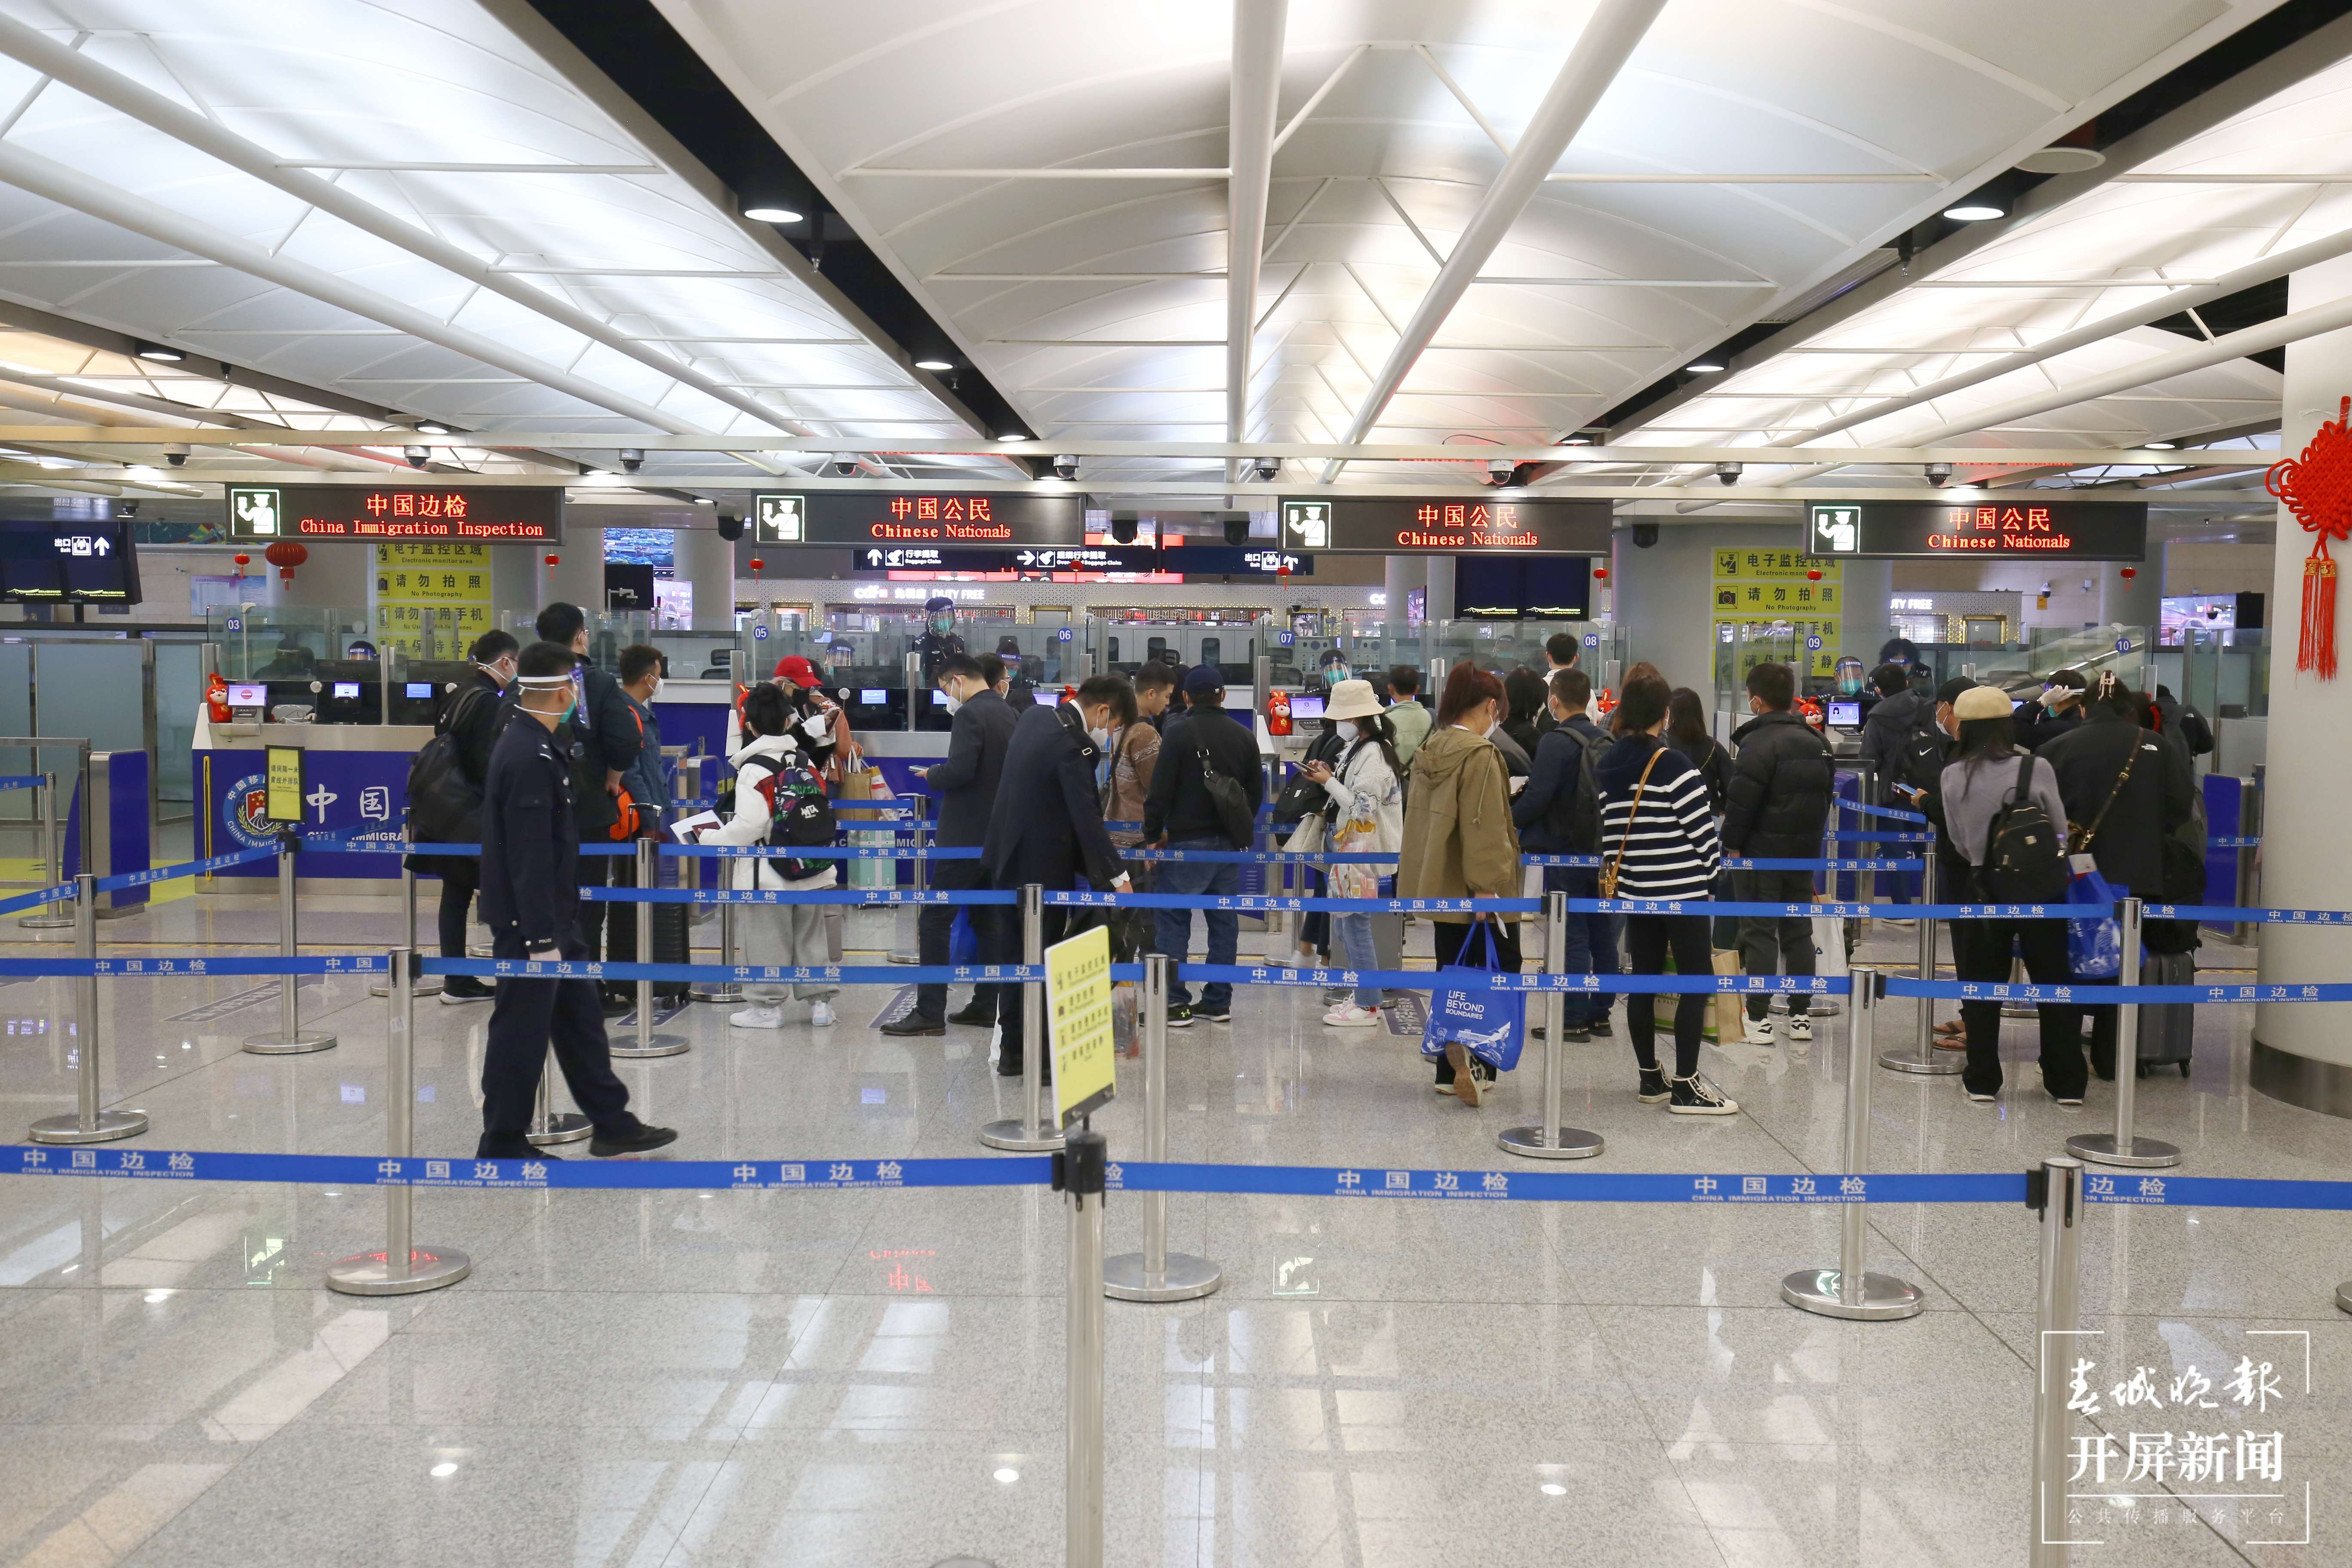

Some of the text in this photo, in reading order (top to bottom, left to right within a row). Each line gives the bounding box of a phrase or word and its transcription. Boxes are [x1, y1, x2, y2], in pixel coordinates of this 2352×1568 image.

[367, 494, 467, 517] 中国边检
[891, 497, 991, 521] 中国公民
[1418, 505, 1517, 528] 中国公民
[1949, 507, 2049, 531] 中国公民
[301, 520, 542, 536] China Immigration Inspection
[872, 524, 1011, 538] Chinese Nationals
[55, 538, 71, 547] 出口
[1398, 532, 1537, 545] Chinese Nationals
[1928, 534, 2070, 548] Chinese Nationals
[395, 544, 482, 555] 电子监控区域
[906, 550, 939, 558] 行李提取
[1245, 553, 1260, 561] 出口
[396, 574, 480, 588] 请勿拍照
[932, 589, 984, 599] DUTY FREE
[1748, 587, 1833, 601] 请勿拍照
[1908, 599, 1932, 609] FREE
[228, 620, 239, 629] 03
[755, 628, 766, 637] 05
[1060, 631, 1071, 640] 06
[1281, 634, 1292, 643] 07
[1585, 636, 1597, 646] 08
[1808, 638, 1820, 648] 09
[2117, 641, 2128, 650] 10
[306, 784, 389, 824] 中国
[227, 821, 245, 842] CHINA
[346, 841, 415, 850] 中国边检
[1118, 849, 1184, 858] 中国边检
[1531, 855, 1599, 863] 中国边检
[206, 853, 240, 867] 中国边检
[129, 868, 168, 882] 中国边检
[695, 891, 777, 900] 中国边检
[867, 891, 948, 900] 中国边检
[1219, 897, 1301, 907] 中国边检
[1390, 899, 1472, 908] 中国边检
[1599, 901, 1681, 910] 中国边检
[1787, 904, 1870, 914] 中国边检
[1960, 906, 2044, 914] 中国边检
[95, 960, 206, 971] 中国边检
[496, 961, 603, 974] 中国边检
[735, 967, 840, 978] 中国边检
[1253, 968, 1358, 983] 中国边检
[1492, 975, 1600, 987] 中国边检
[1718, 977, 1828, 989] 中国边检
[1448, 990, 1466, 1001] LIFE
[1963, 984, 2071, 998] 中国边检
[2209, 986, 2318, 997] 中国边检
[1447, 999, 1484, 1013] BEYOND
[1446, 1008, 1483, 1020] BOUNDARIES
[24, 1149, 194, 1169] 中国边检
[378, 1160, 547, 1180] 中国边检
[734, 1161, 903, 1182] 中国边检
[1338, 1170, 1508, 1191] 中国边检
[1694, 1176, 1866, 1194] 中国边检
